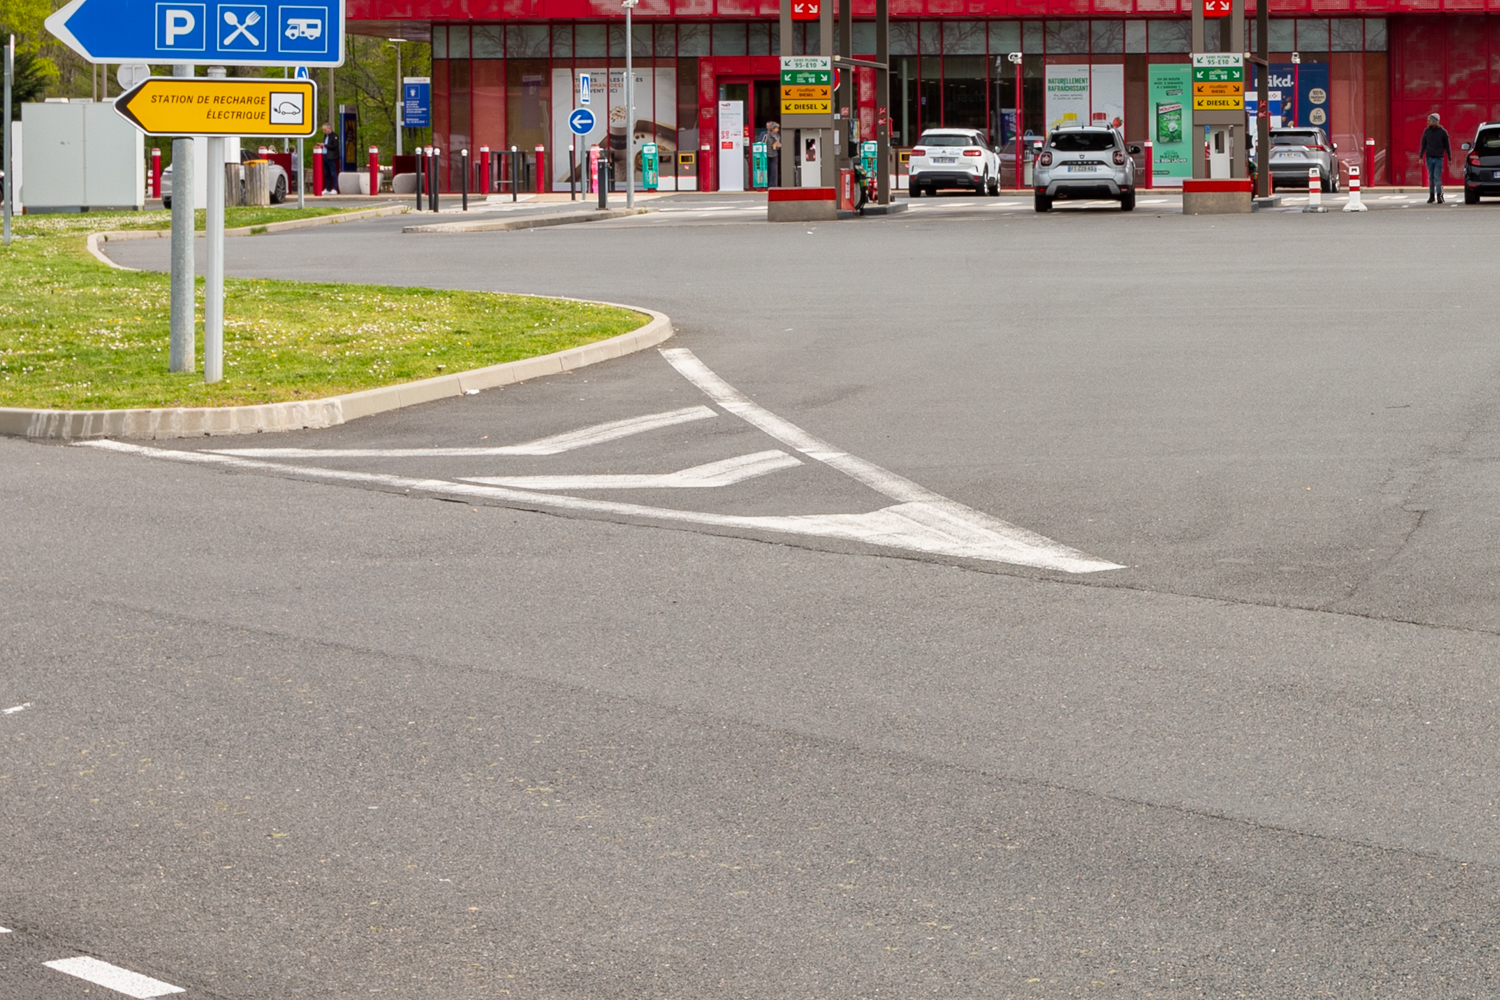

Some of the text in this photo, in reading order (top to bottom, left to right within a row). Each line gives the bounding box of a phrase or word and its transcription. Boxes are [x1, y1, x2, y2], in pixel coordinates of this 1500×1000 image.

[151, 95, 266, 105] STATION DE RECHARGE
[206, 109, 266, 120] ÉLECTRIQUE
